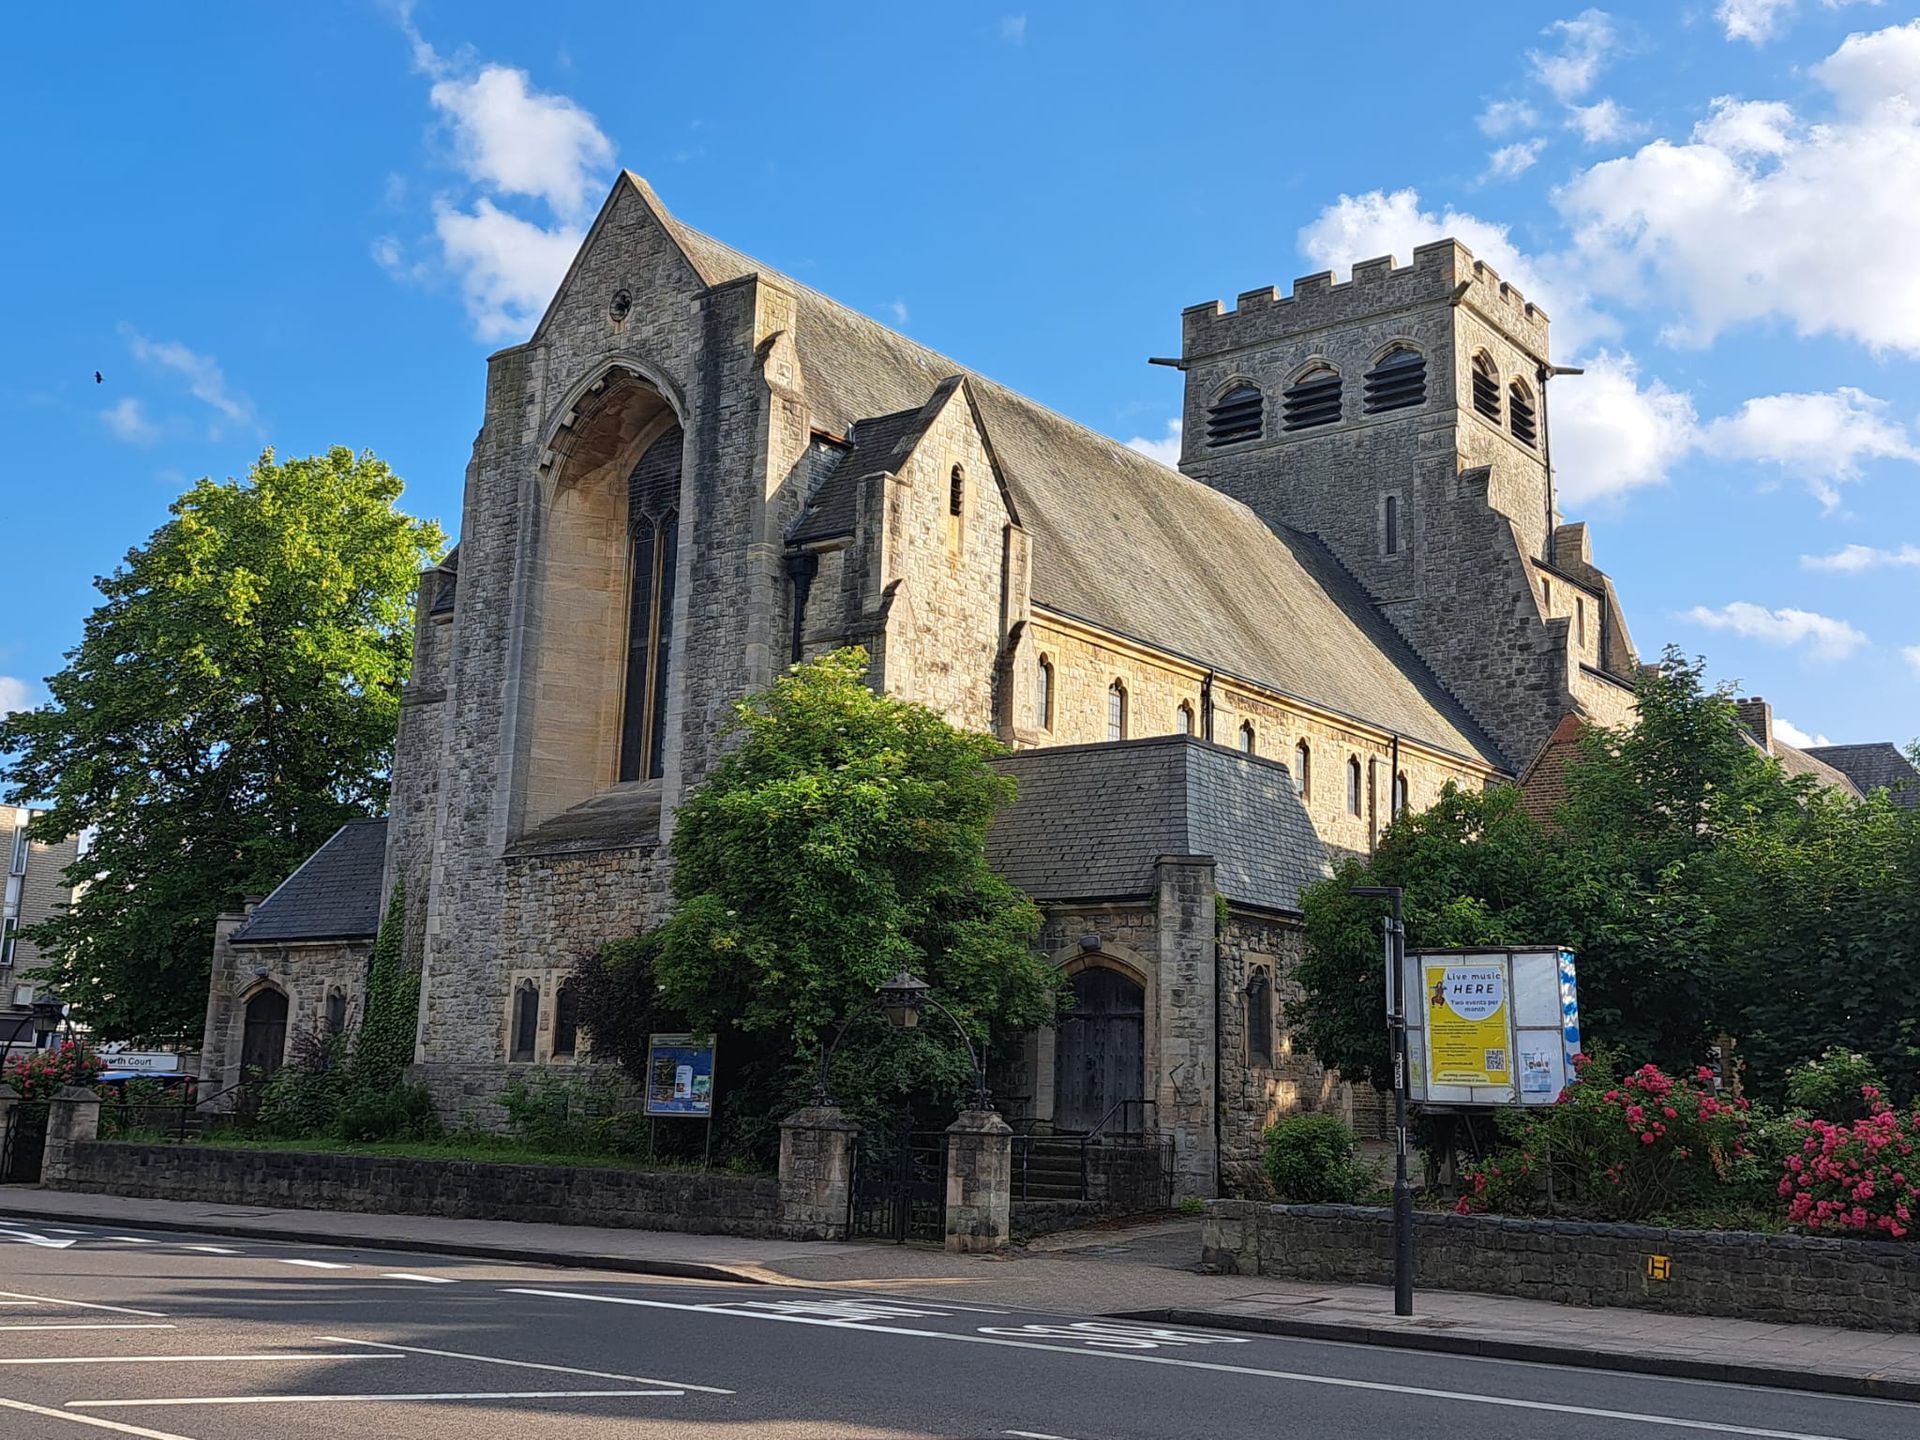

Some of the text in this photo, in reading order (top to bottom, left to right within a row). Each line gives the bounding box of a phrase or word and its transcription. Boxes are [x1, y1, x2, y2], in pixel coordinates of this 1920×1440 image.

[1446, 972, 1501, 981] Live music
[1453, 983, 1495, 994] HERE
[128, 1057, 152, 1066] Court
[976, 1322, 1253, 1349] BUS
